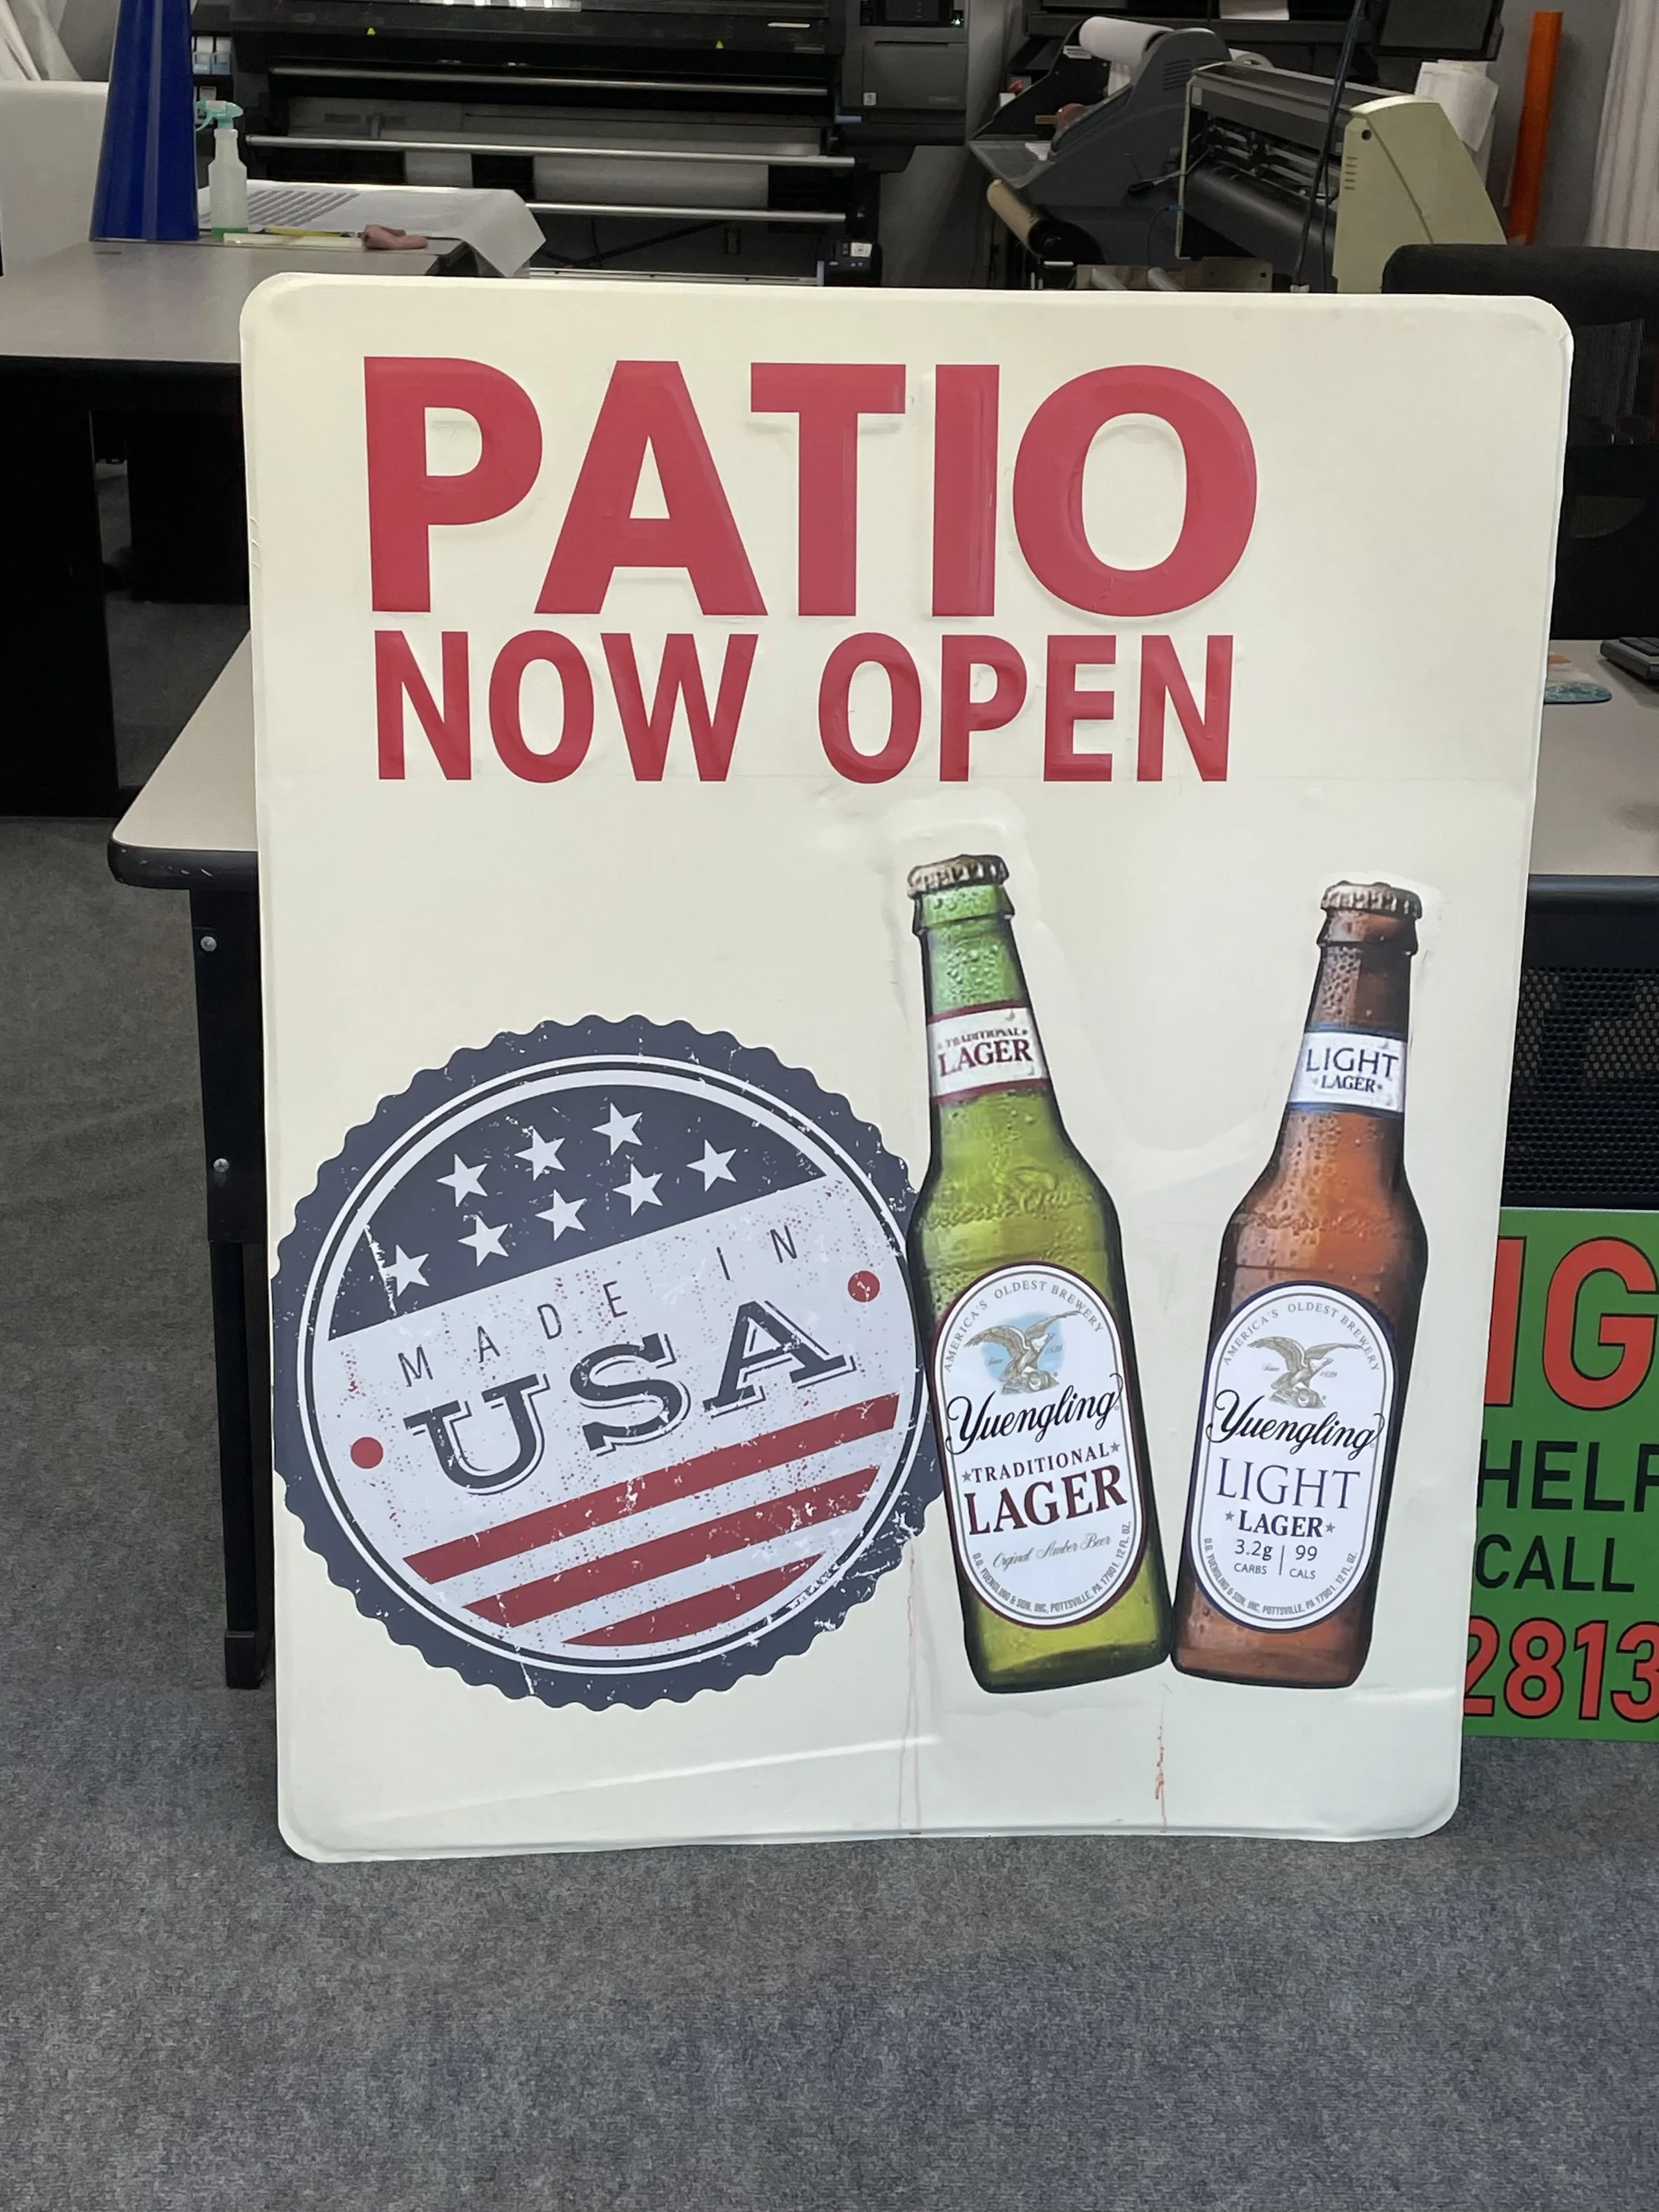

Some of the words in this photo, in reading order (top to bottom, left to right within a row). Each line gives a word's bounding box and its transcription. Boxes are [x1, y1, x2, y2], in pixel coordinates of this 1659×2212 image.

[364, 356, 1258, 617] PATIO
[374, 630, 758, 784] NOW
[819, 632, 1233, 784] OPEN
[938, 1039, 1033, 1077] LAGER
[1305, 1047, 1399, 1078] LIGHT
[1321, 1074, 1376, 1093] LAGER
[398, 1280, 628, 1387] MADE
[716, 1225, 798, 1281] IN
[944, 1299, 987, 1373] AMERICA'S
[994, 1280, 1047, 1299] OLDEST
[1050, 1284, 1104, 1333] BREWERY
[1222, 1308, 1279, 1366] AMERICA'S
[1287, 1301, 1339, 1319] OLDEST
[1339, 1314, 1380, 1372] BREWERY
[402, 1301, 857, 1496] USA
[945, 1373, 1123, 1455] Yuengling
[1205, 1389, 1386, 1461] Yuengling
[972, 1442, 1110, 1483] TRADITIONAL
[1216, 1456, 1360, 1509] LIGHT
[964, 1464, 1128, 1536] LAGER
[1238, 1509, 1324, 1538] LAGER
[1080, 1532, 1112, 1550] Beer
[1234, 1538, 1273, 1562] 3.2g
[1295, 1544, 1318, 1562] 99
[1234, 1563, 1267, 1575] CARBS
[1289, 1568, 1316, 1580] CALS
[1475, 1533, 1636, 1593] CALL
[1463, 1615, 1659, 1722] 2813
